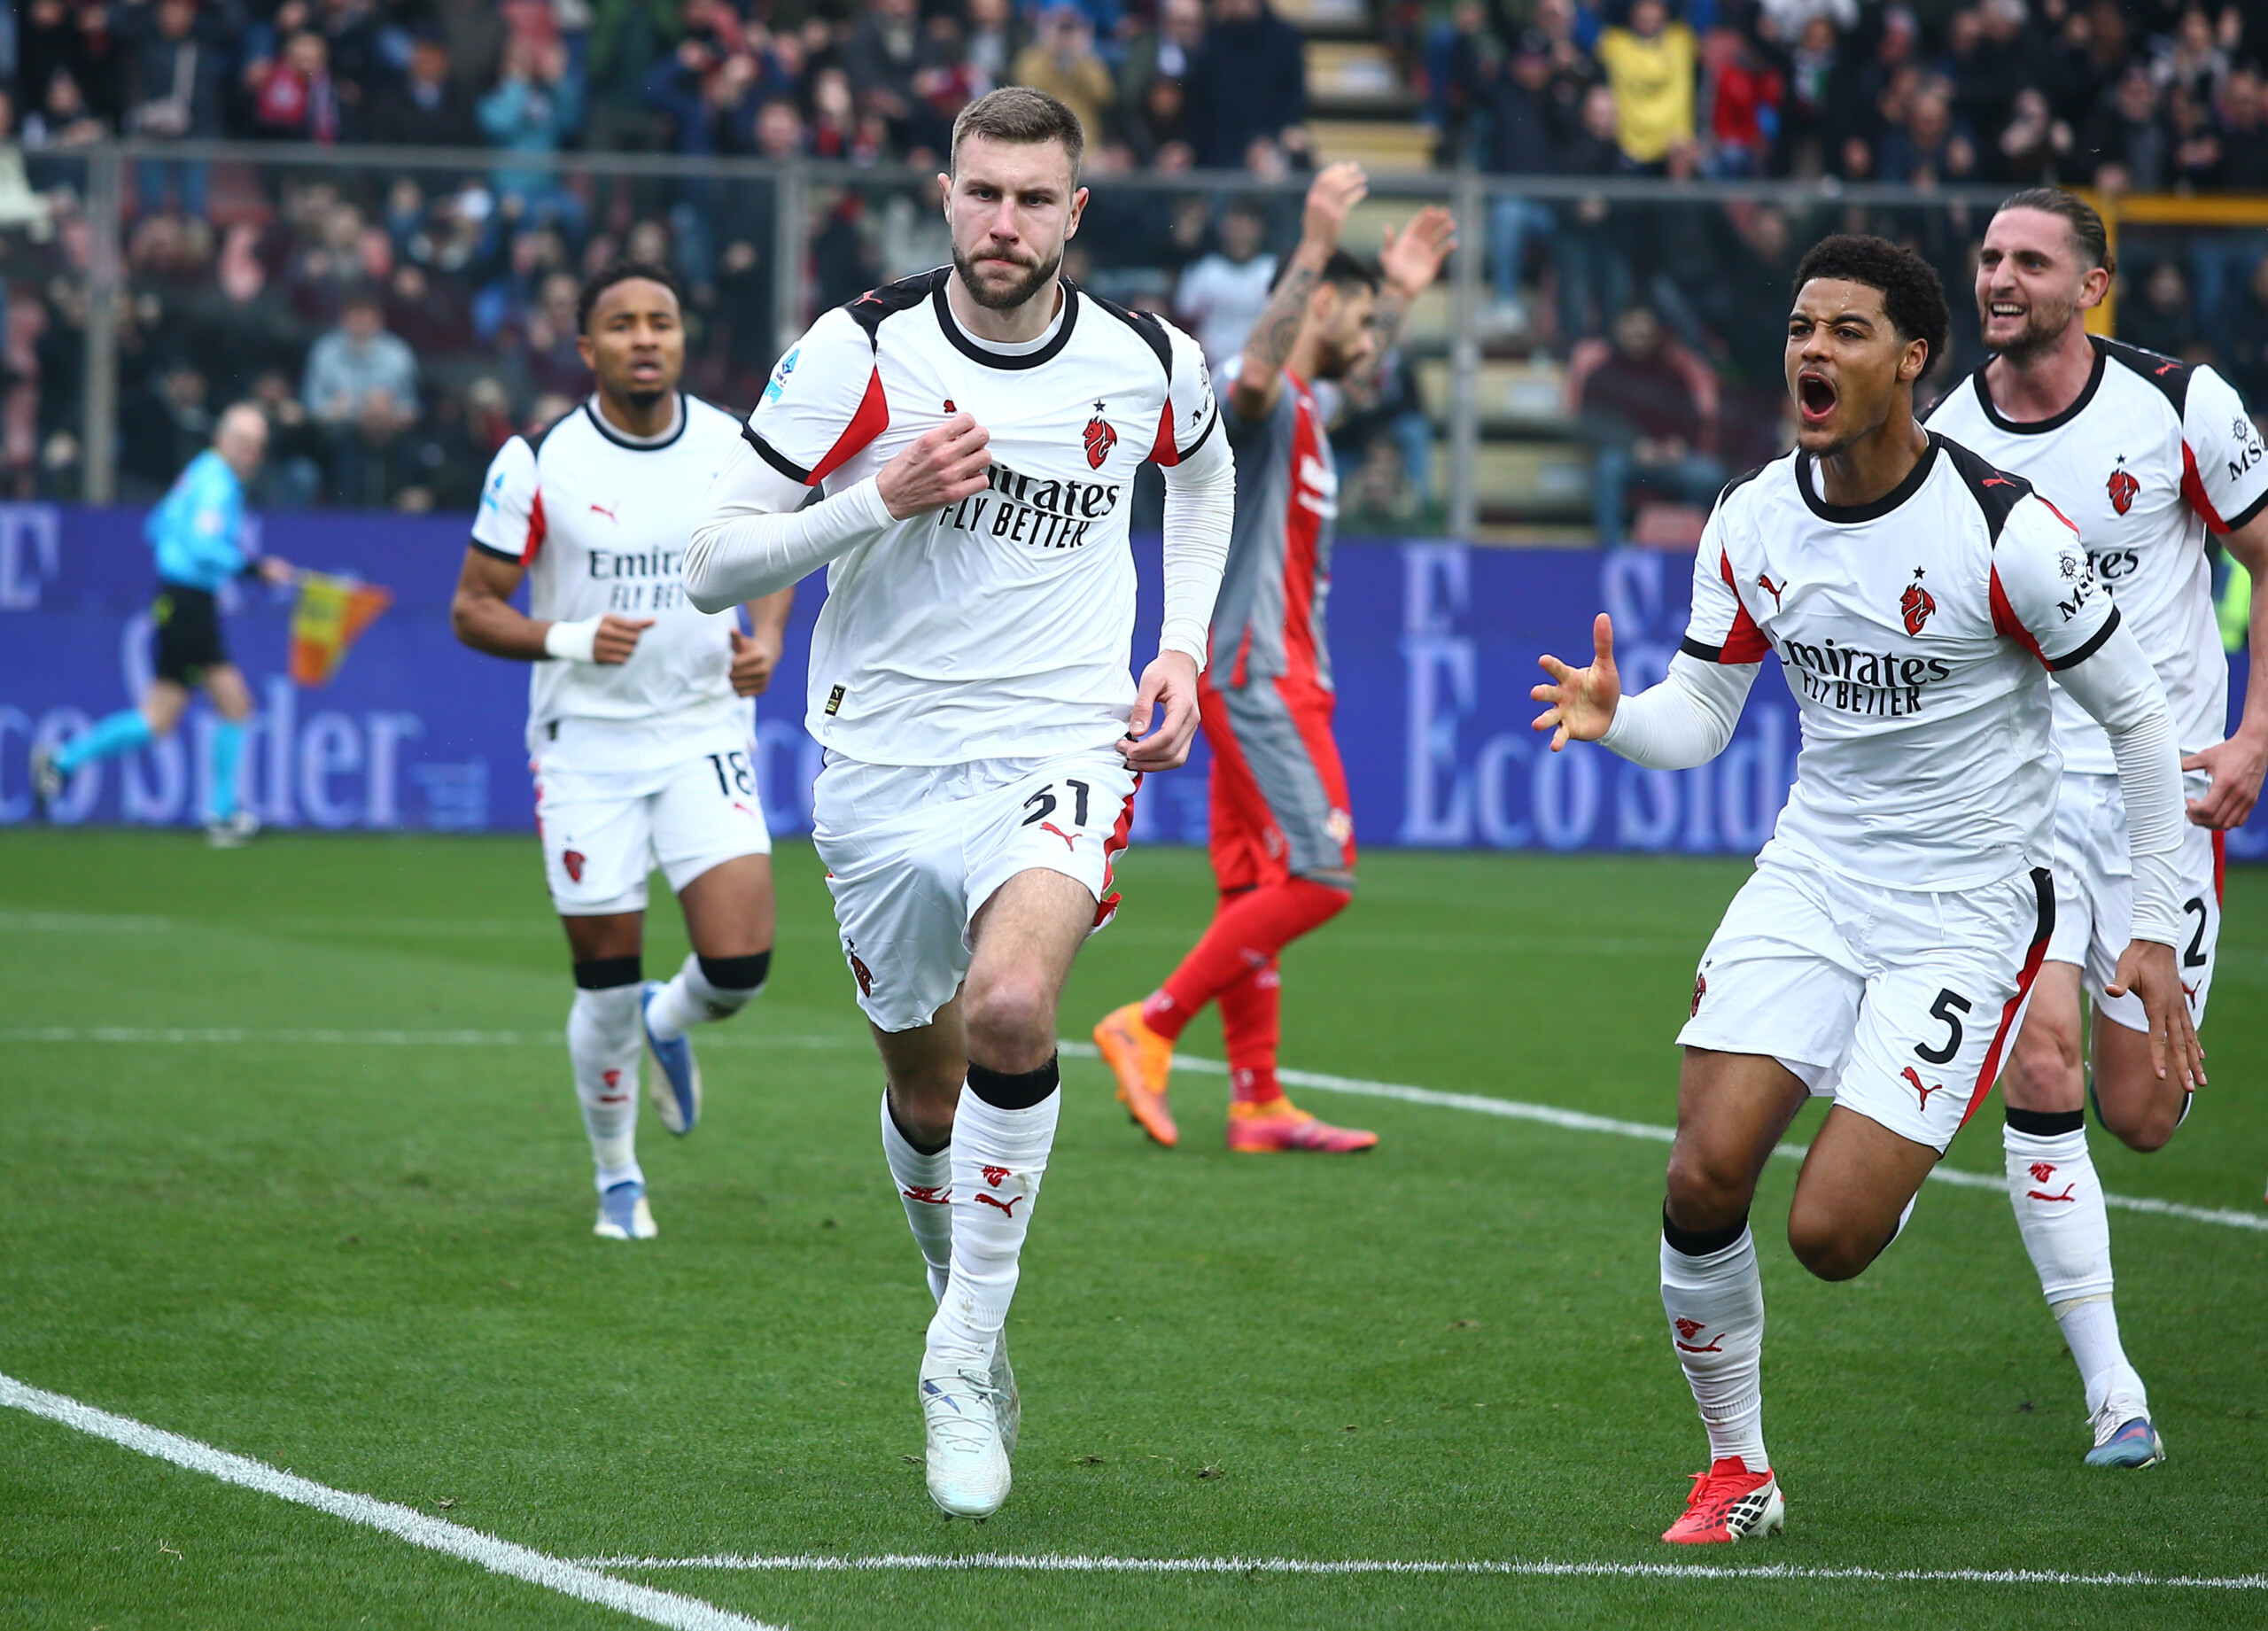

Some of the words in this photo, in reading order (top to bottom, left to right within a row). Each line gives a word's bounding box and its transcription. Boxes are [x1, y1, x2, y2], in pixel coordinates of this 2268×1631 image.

[987, 464, 1120, 518] irates
[991, 502, 1091, 548] BETTER
[588, 544, 683, 580] Emir
[1398, 634, 1601, 852] Eco
[704, 751, 752, 796] 18
[1021, 779, 1090, 827] 51
[1914, 987, 1972, 1064] 5
